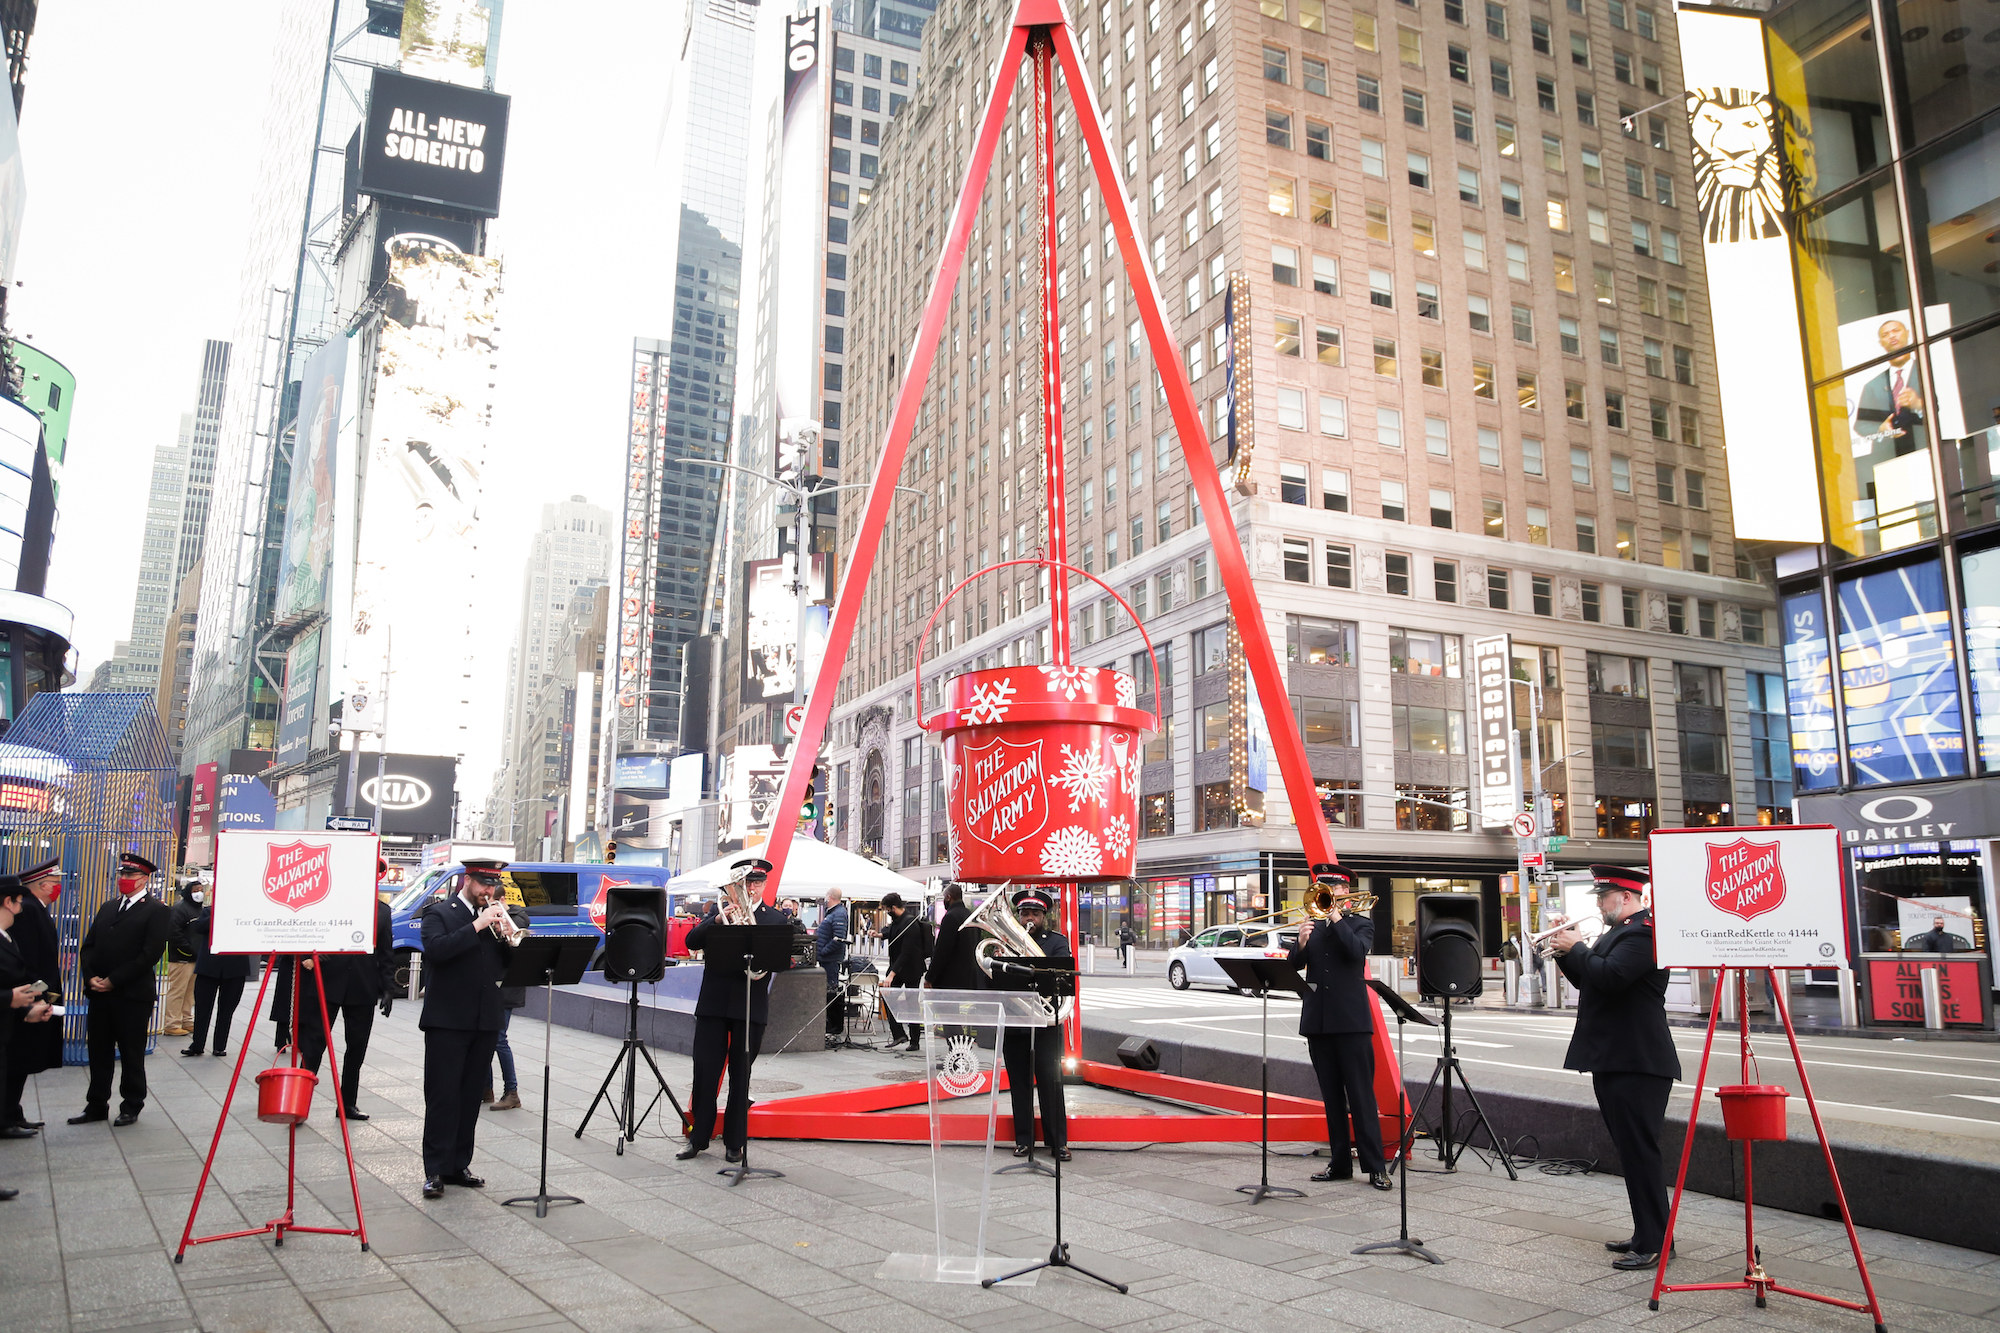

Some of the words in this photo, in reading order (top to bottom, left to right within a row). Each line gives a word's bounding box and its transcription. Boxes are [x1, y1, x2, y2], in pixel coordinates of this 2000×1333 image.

[388, 107, 486, 147] ALL-NEW
[384, 133, 484, 173] SORENTO
[975, 746, 1006, 786] THE
[373, 782, 420, 802] KIA
[968, 750, 1038, 826] SALVATION
[990, 784, 1036, 840] ARMY
[1846, 823, 1953, 842] OAKLEY
[267, 851, 325, 894] SALVATION
[277, 848, 304, 870] THE
[1711, 850, 1775, 900] SALVATION
[1719, 846, 1748, 873] THE
[286, 871, 323, 903] ARMY
[1735, 873, 1774, 910] ARMY
[234, 918, 251, 926] Text
[253, 918, 316, 926] GiantRedKettle
[1679, 930, 1698, 938] Text
[1700, 930, 1774, 938] GiantRedKettle
[1788, 929, 1818, 937] 41444
[1896, 984, 1951, 999] TIMS
[1891, 1002, 1961, 1019] SQURE
